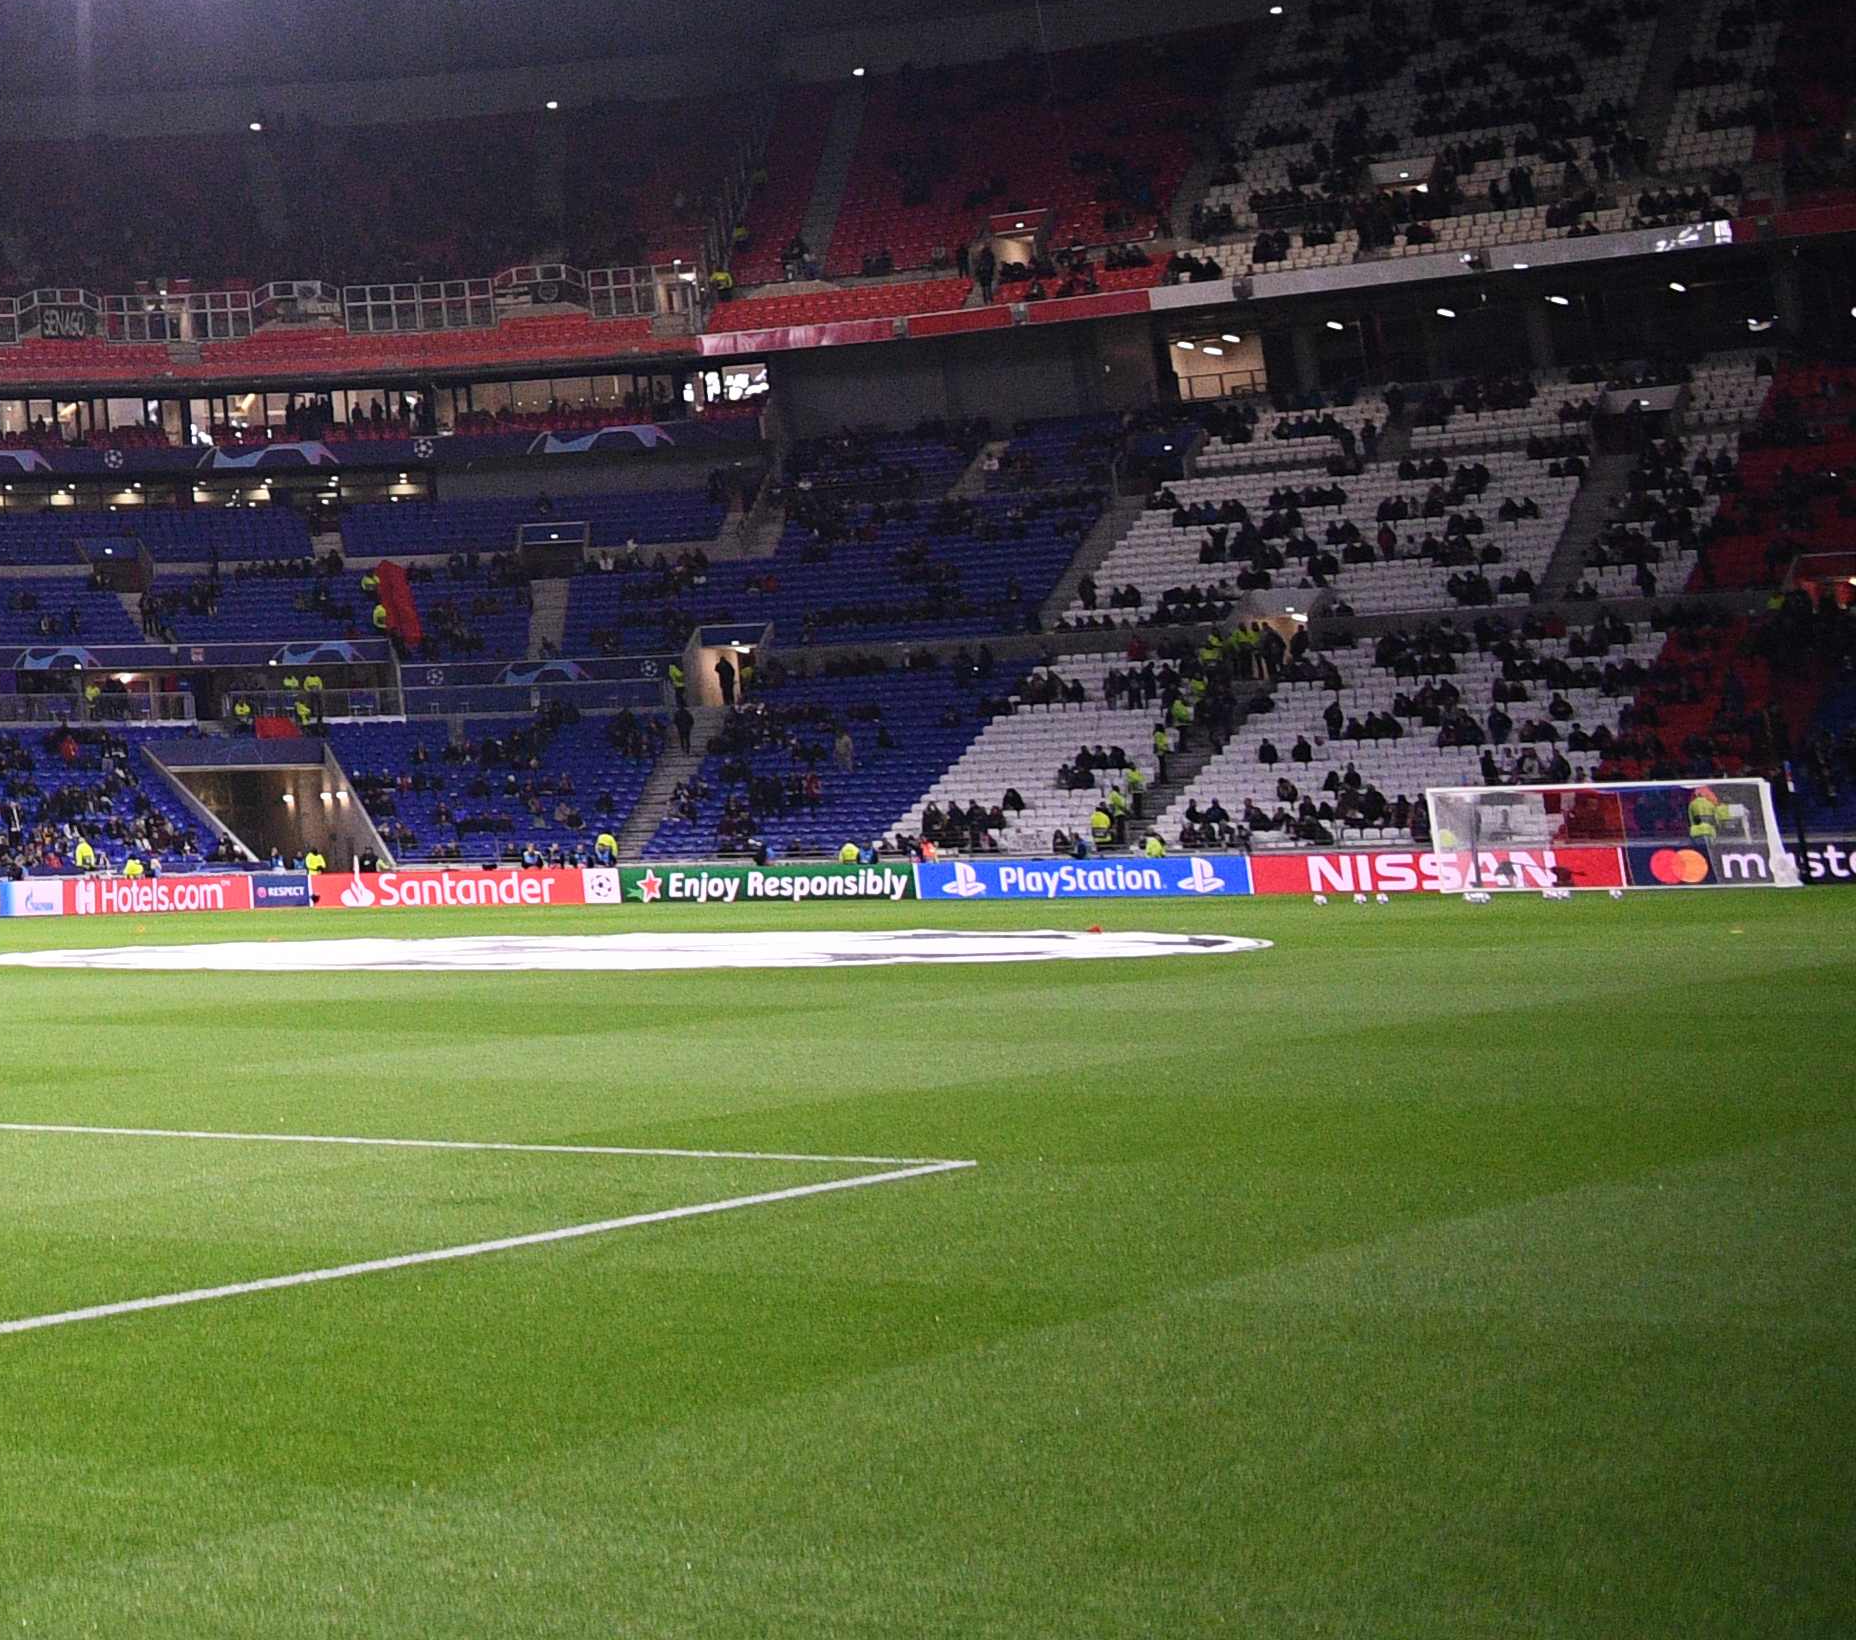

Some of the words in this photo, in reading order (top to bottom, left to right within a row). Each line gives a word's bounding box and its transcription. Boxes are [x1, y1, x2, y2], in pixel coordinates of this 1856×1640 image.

[379, 870, 555, 906] Santander
[668, 871, 740, 903] Enjoy
[747, 868, 908, 902] Responsibly
[999, 865, 1162, 898] PlayStation
[1308, 851, 1558, 892] NISSAN
[101, 878, 224, 912] Hotels.com
[267, 886, 304, 897] RESPECT
